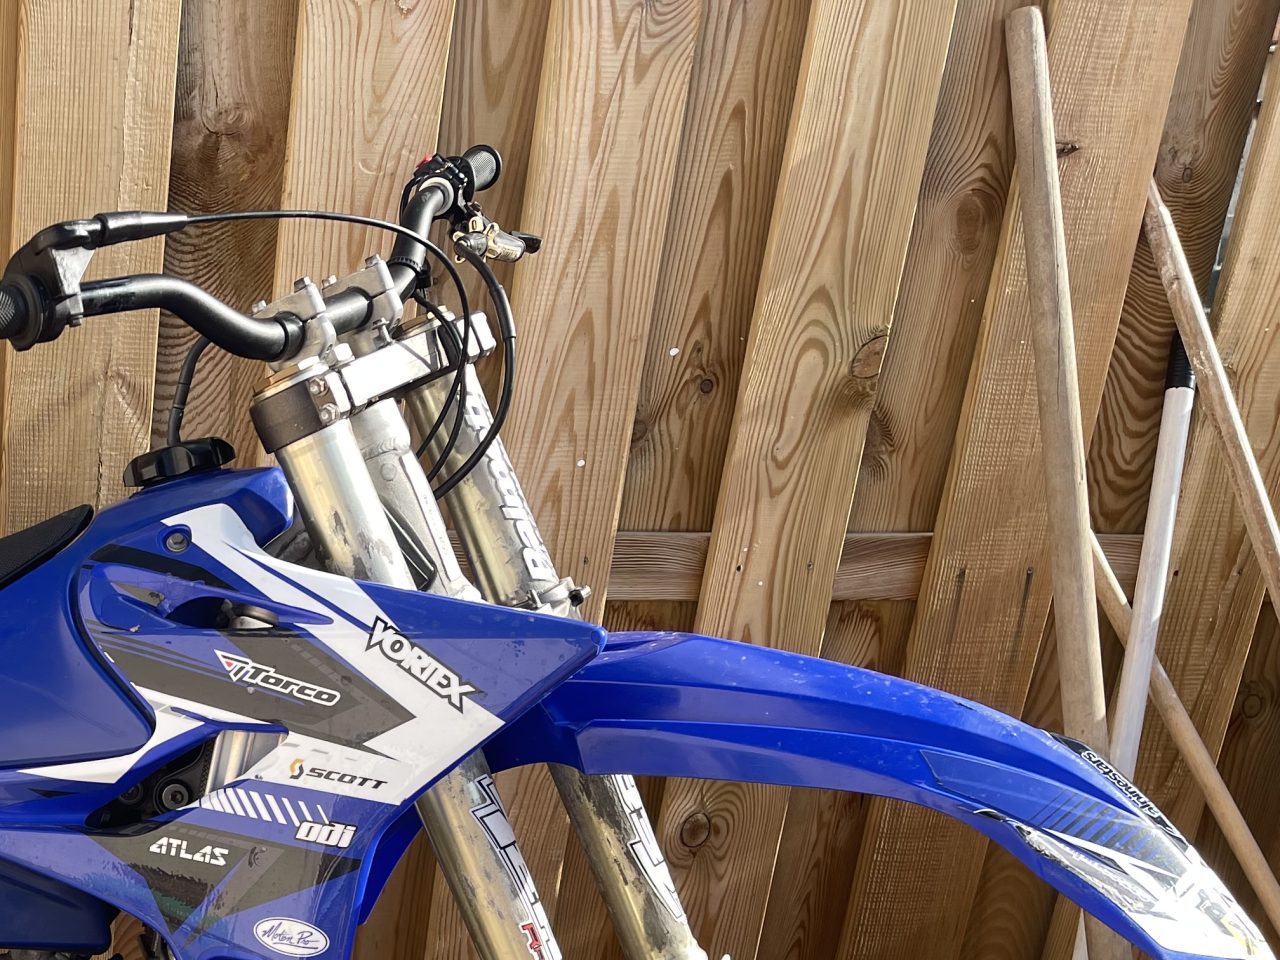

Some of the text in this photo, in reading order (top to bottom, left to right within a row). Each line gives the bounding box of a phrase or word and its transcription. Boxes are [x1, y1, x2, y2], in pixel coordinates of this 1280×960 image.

[365, 615, 484, 714] VORTEX
[242, 661, 341, 706] Torco
[305, 767, 388, 789] SCOTT
[149, 836, 229, 866] ATLAS
